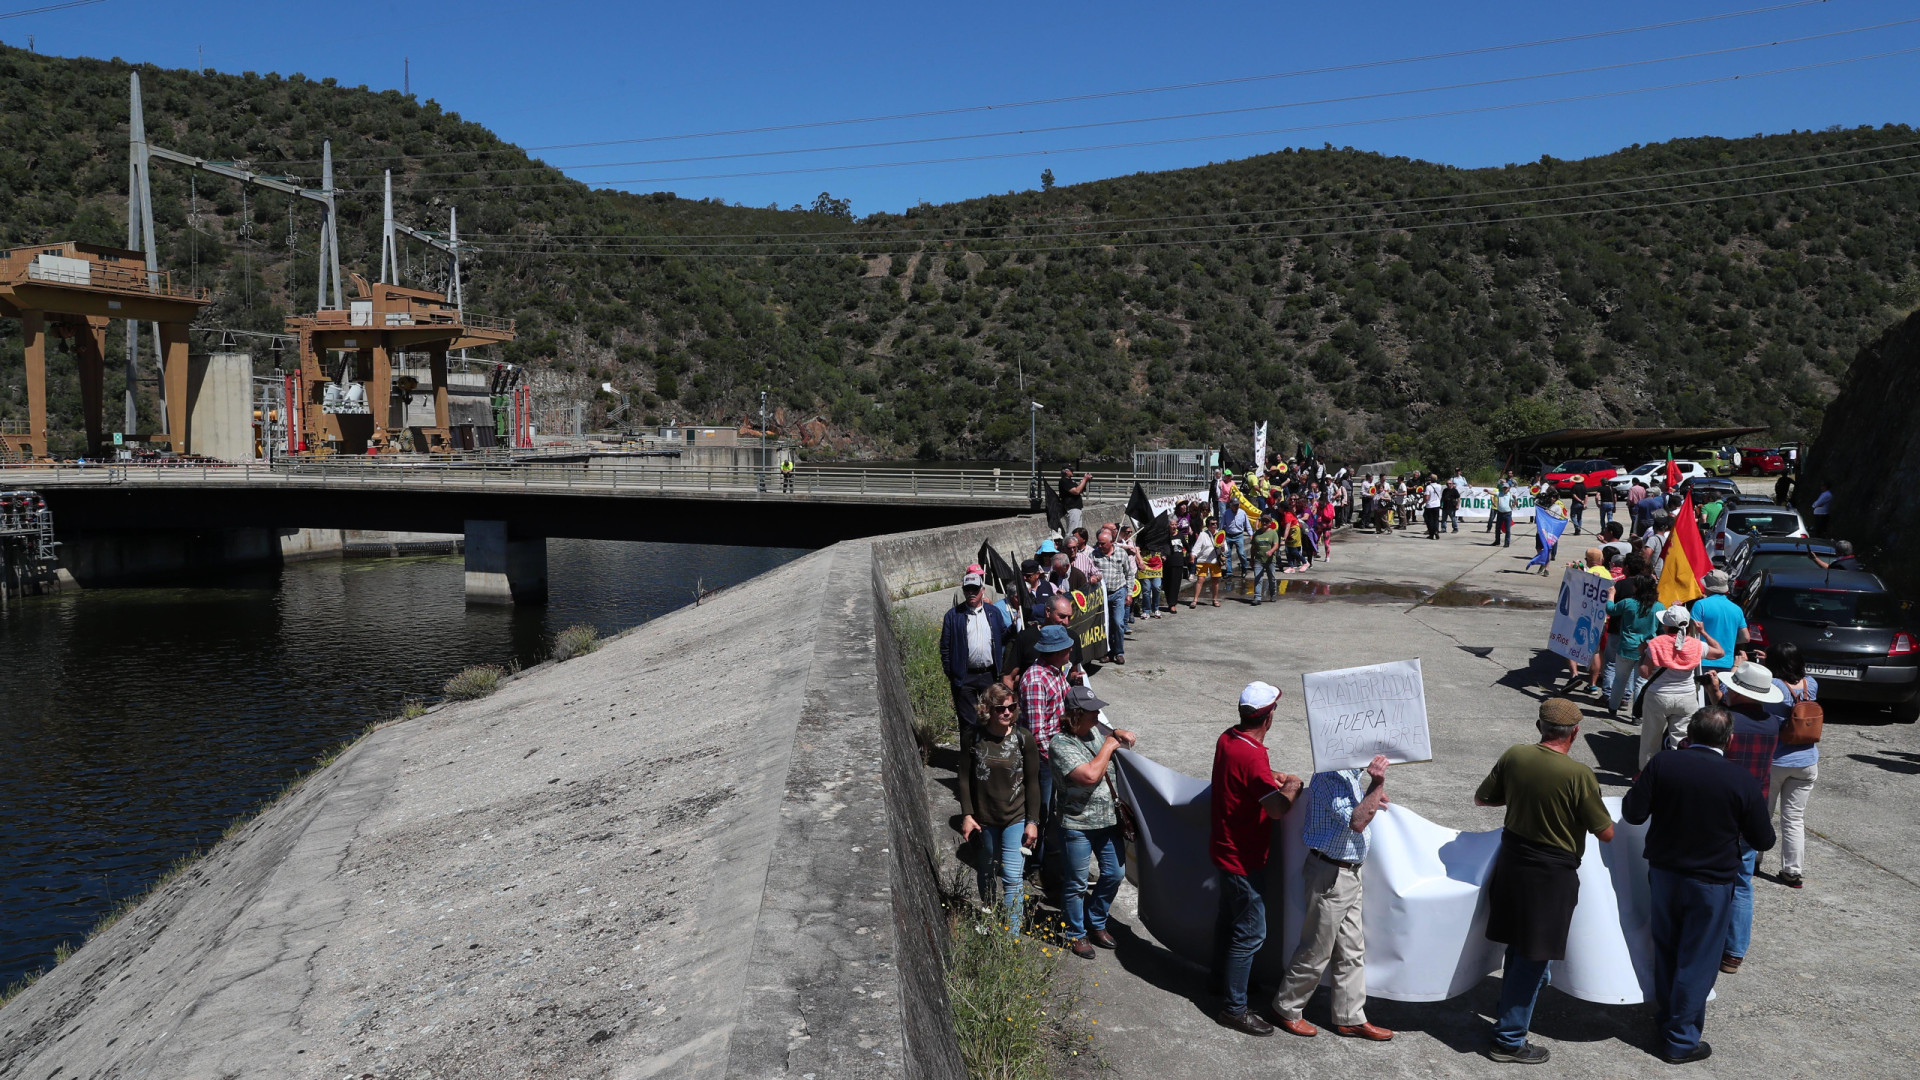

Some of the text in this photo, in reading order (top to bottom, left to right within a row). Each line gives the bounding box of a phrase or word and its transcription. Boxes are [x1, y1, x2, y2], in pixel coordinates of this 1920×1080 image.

[1474, 498, 1485, 509] DE
[1583, 579, 1608, 603] rede
[1557, 633, 1569, 646] Rios
[1568, 647, 1582, 658] red
[1836, 667, 1855, 676] DCN
[1310, 672, 1421, 707] ALAMBRADAS
[1324, 725, 1364, 757] PASO
